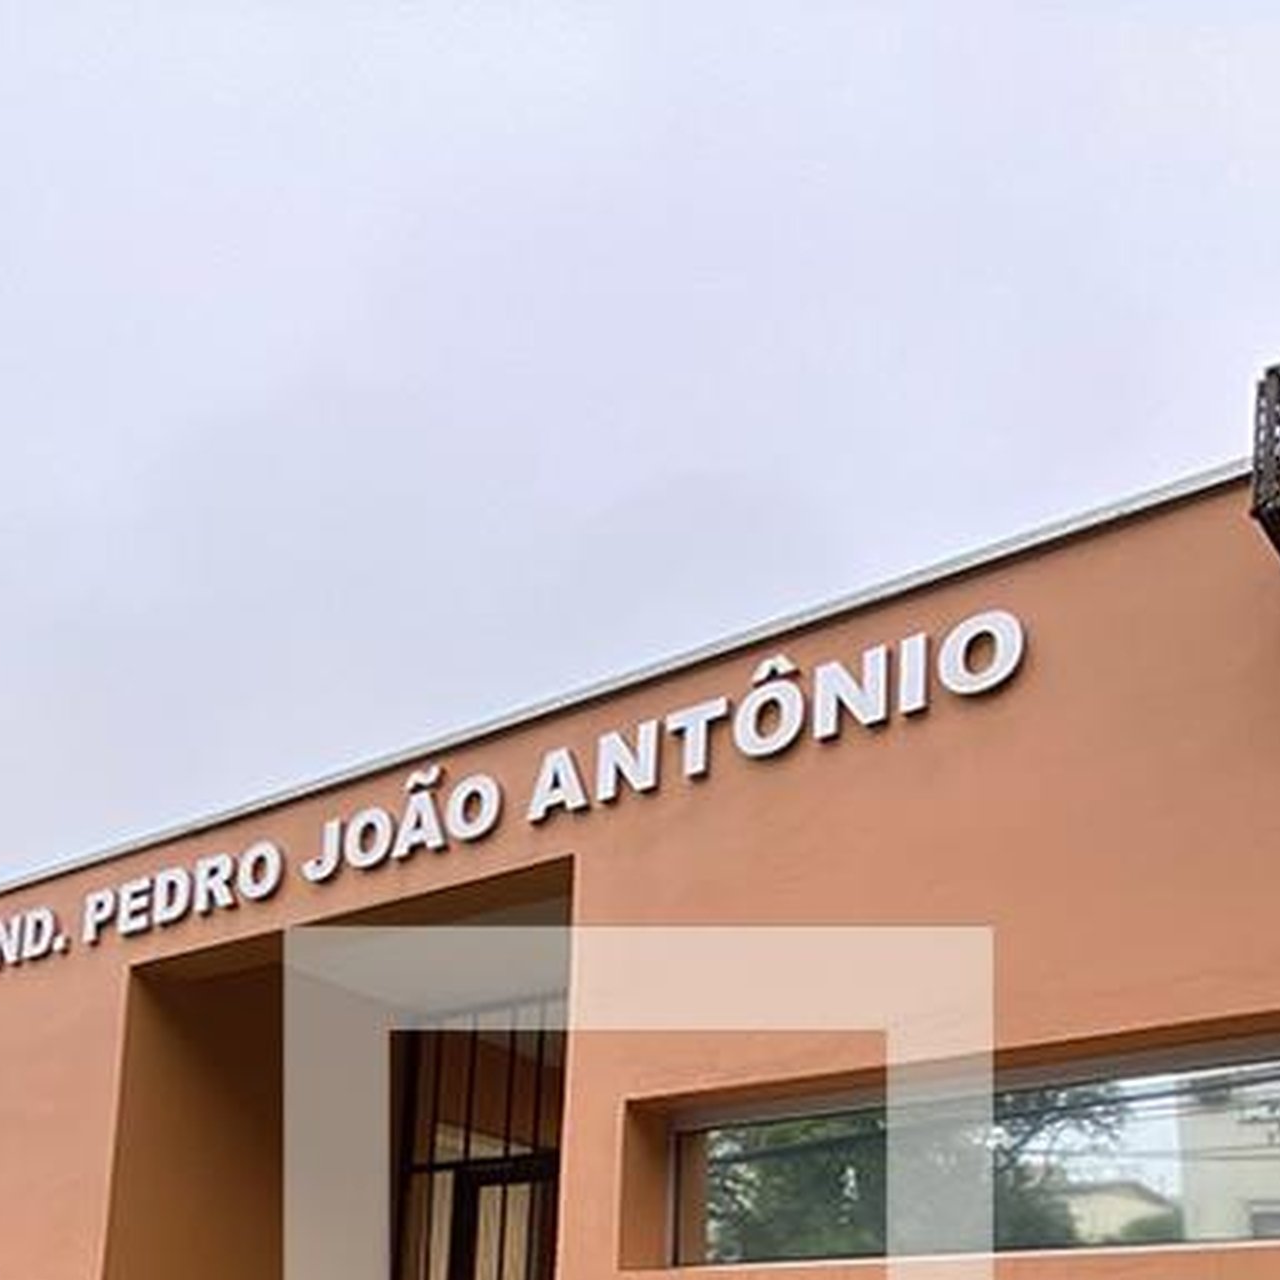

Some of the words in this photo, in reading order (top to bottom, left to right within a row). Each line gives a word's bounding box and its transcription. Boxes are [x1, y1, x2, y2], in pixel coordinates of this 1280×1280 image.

[81, 840, 284, 945] PEDRO
[301, 765, 502, 883] JOÃO
[527, 609, 1026, 823] ANTÔNIO
